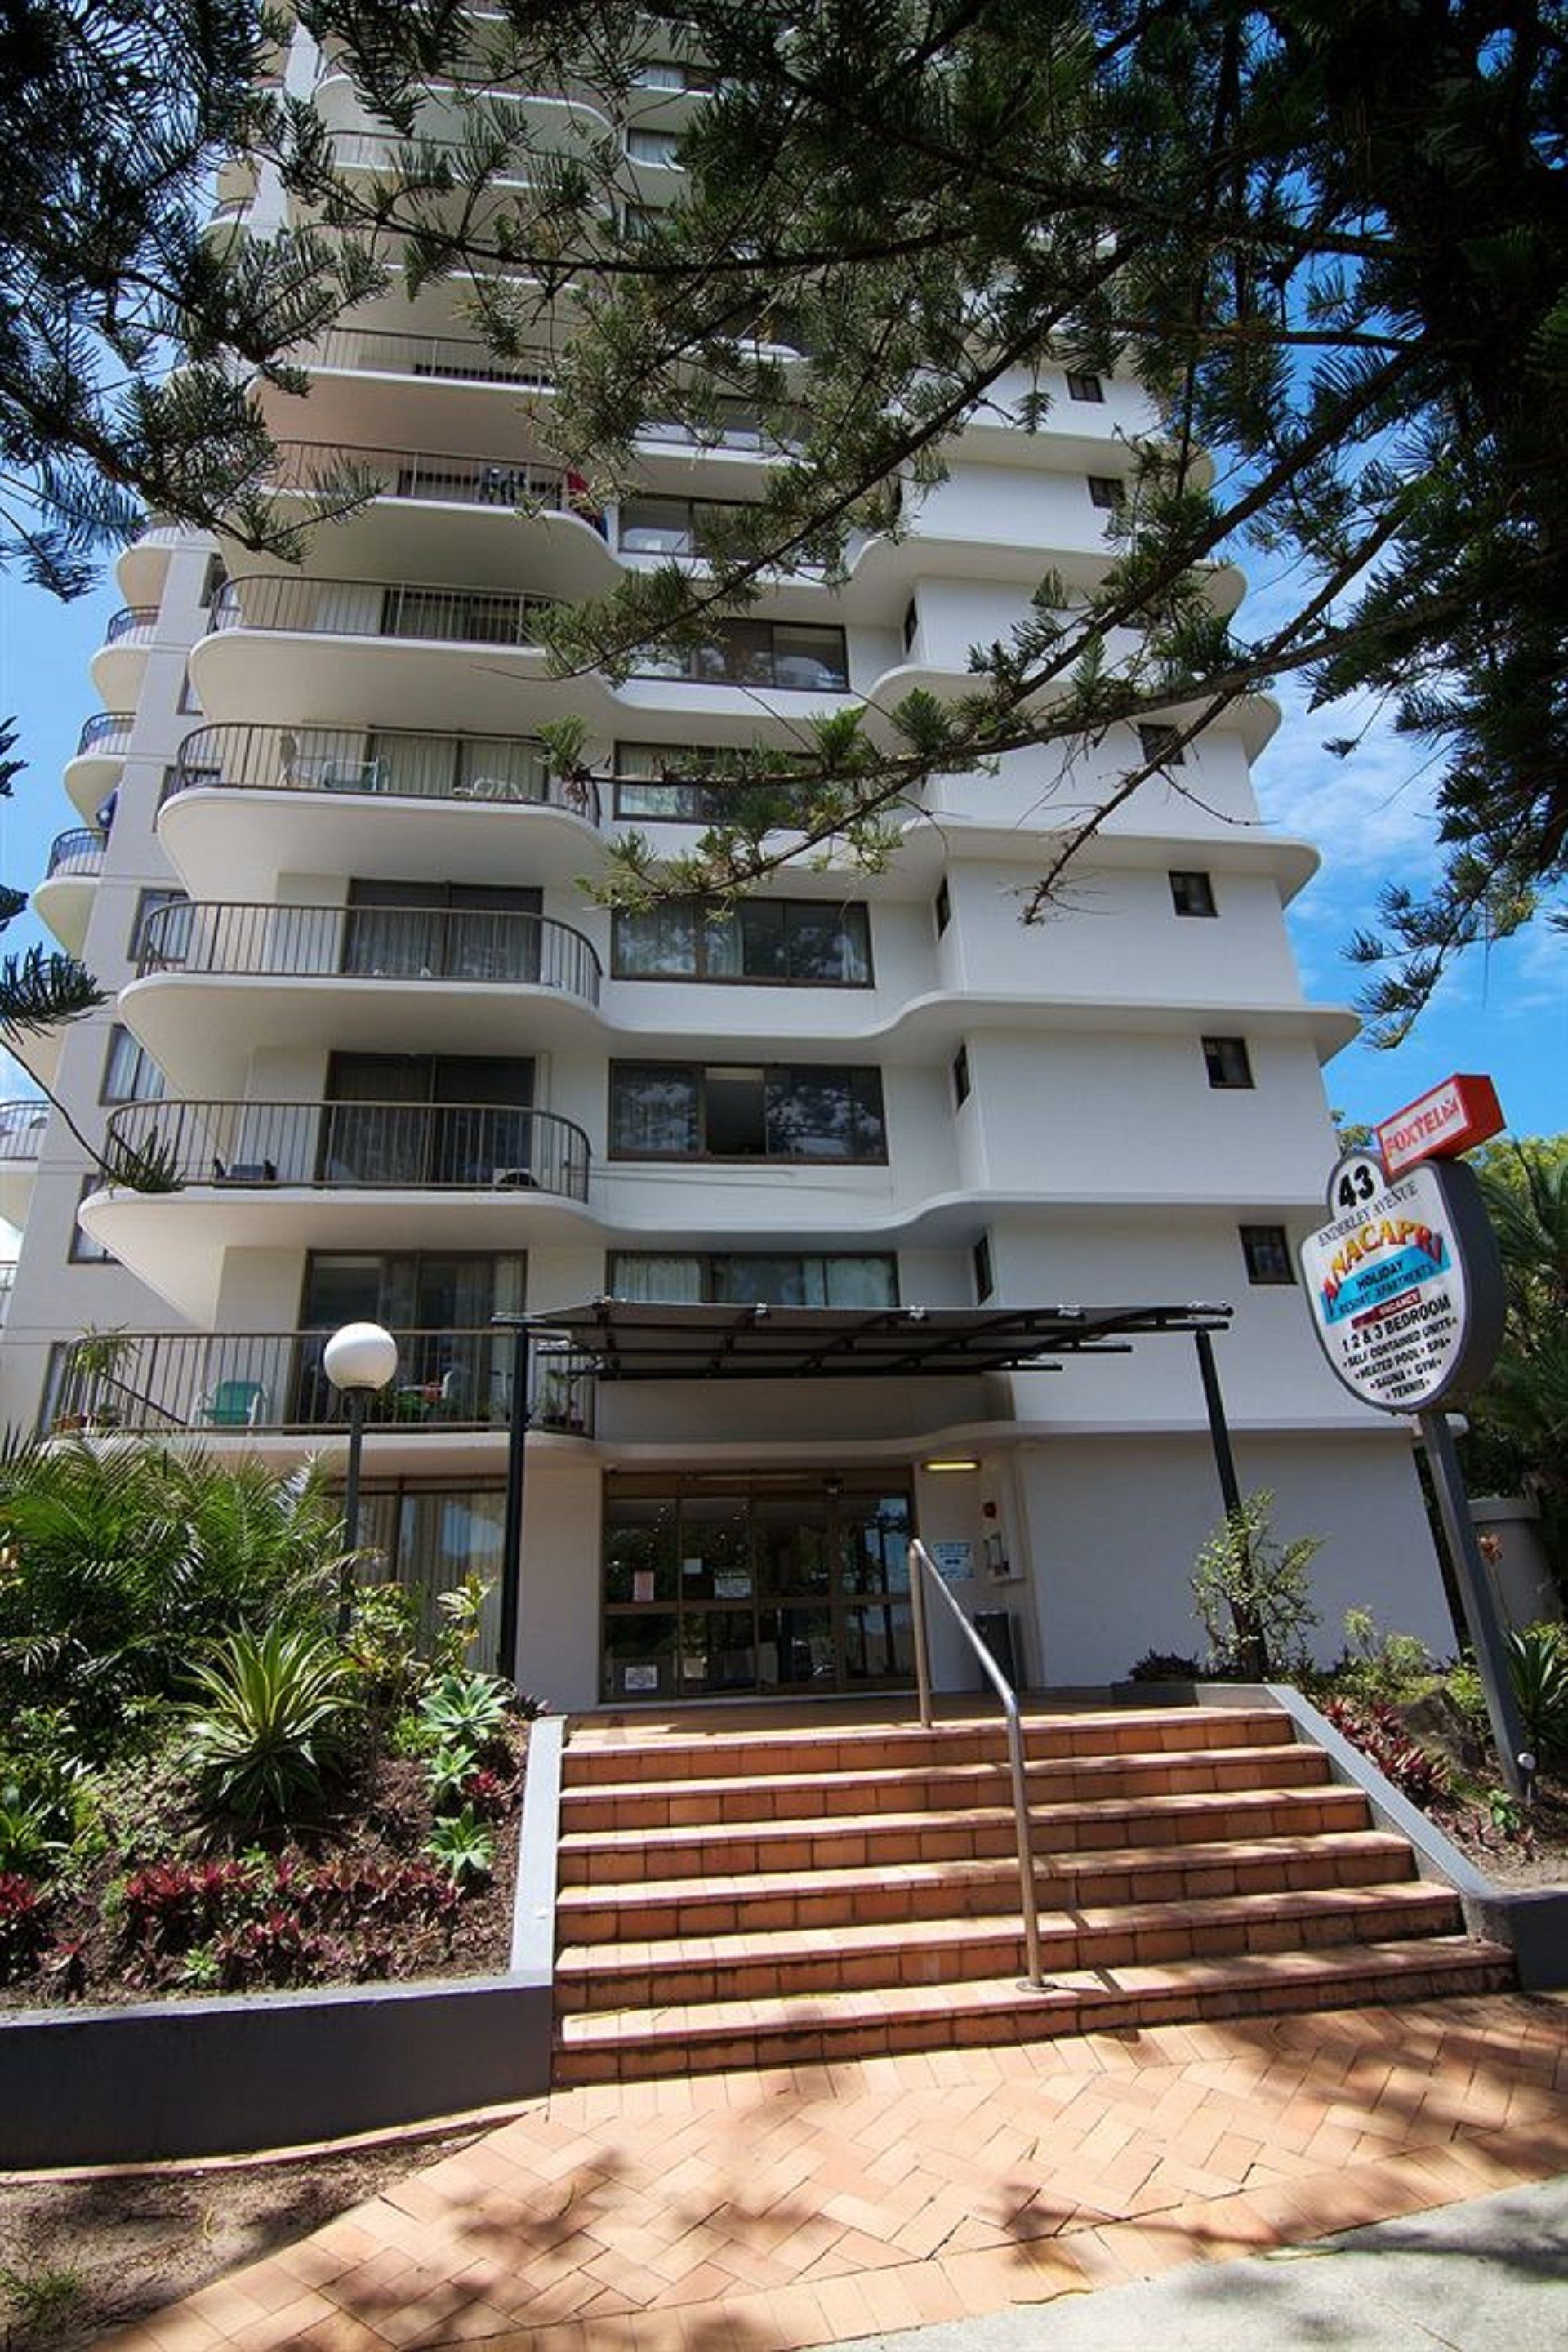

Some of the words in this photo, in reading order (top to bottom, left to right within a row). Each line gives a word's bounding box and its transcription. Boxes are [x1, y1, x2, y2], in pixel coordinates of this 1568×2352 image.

[1339, 1165, 1375, 1207] 43
[1373, 1181, 1419, 1215] AVENUE
[1356, 1260, 1404, 1291] HOLIDAY
[1352, 1333, 1360, 1349] 2
[1374, 1323, 1383, 1339] 3
[1384, 1294, 1451, 1335] BEDROOM
[1370, 1330, 1421, 1358] CONTAINED
[1423, 1317, 1452, 1338] UNITS
[1359, 1357, 1393, 1379] HEATED
[1395, 1348, 1420, 1366] POOL
[1375, 1370, 1406, 1389] SAUNA
[1415, 1358, 1437, 1375] GYM
[1391, 1378, 1425, 1398] TENNIS
